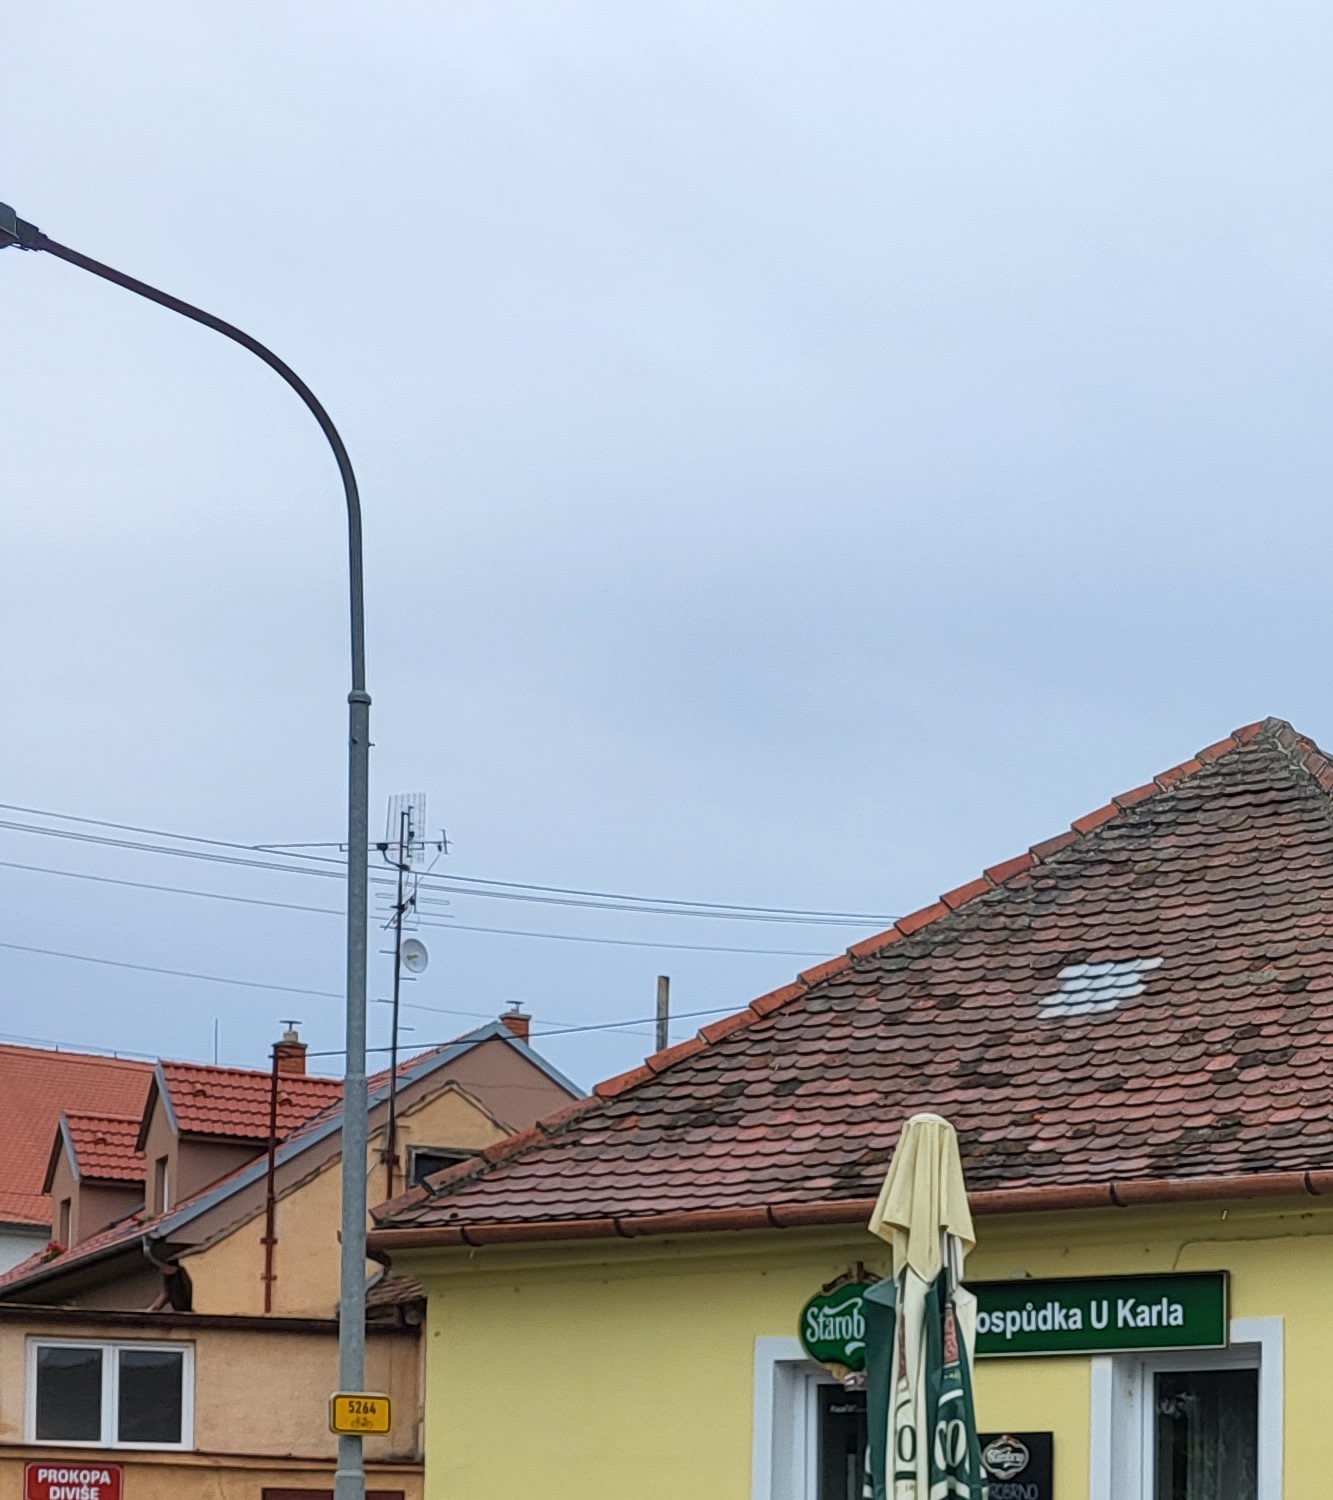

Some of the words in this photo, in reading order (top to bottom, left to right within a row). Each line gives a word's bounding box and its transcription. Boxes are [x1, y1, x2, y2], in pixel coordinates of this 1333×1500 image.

[806, 1297, 866, 1356] Starob
[976, 1301, 1083, 1340] ospůdka
[1090, 1300, 1109, 1330] U
[1117, 1297, 1184, 1329] Karla
[348, 1400, 377, 1415] 5264
[37, 1468, 112, 1485] PROKOPA
[49, 1484, 100, 1500] DIVIŠE
